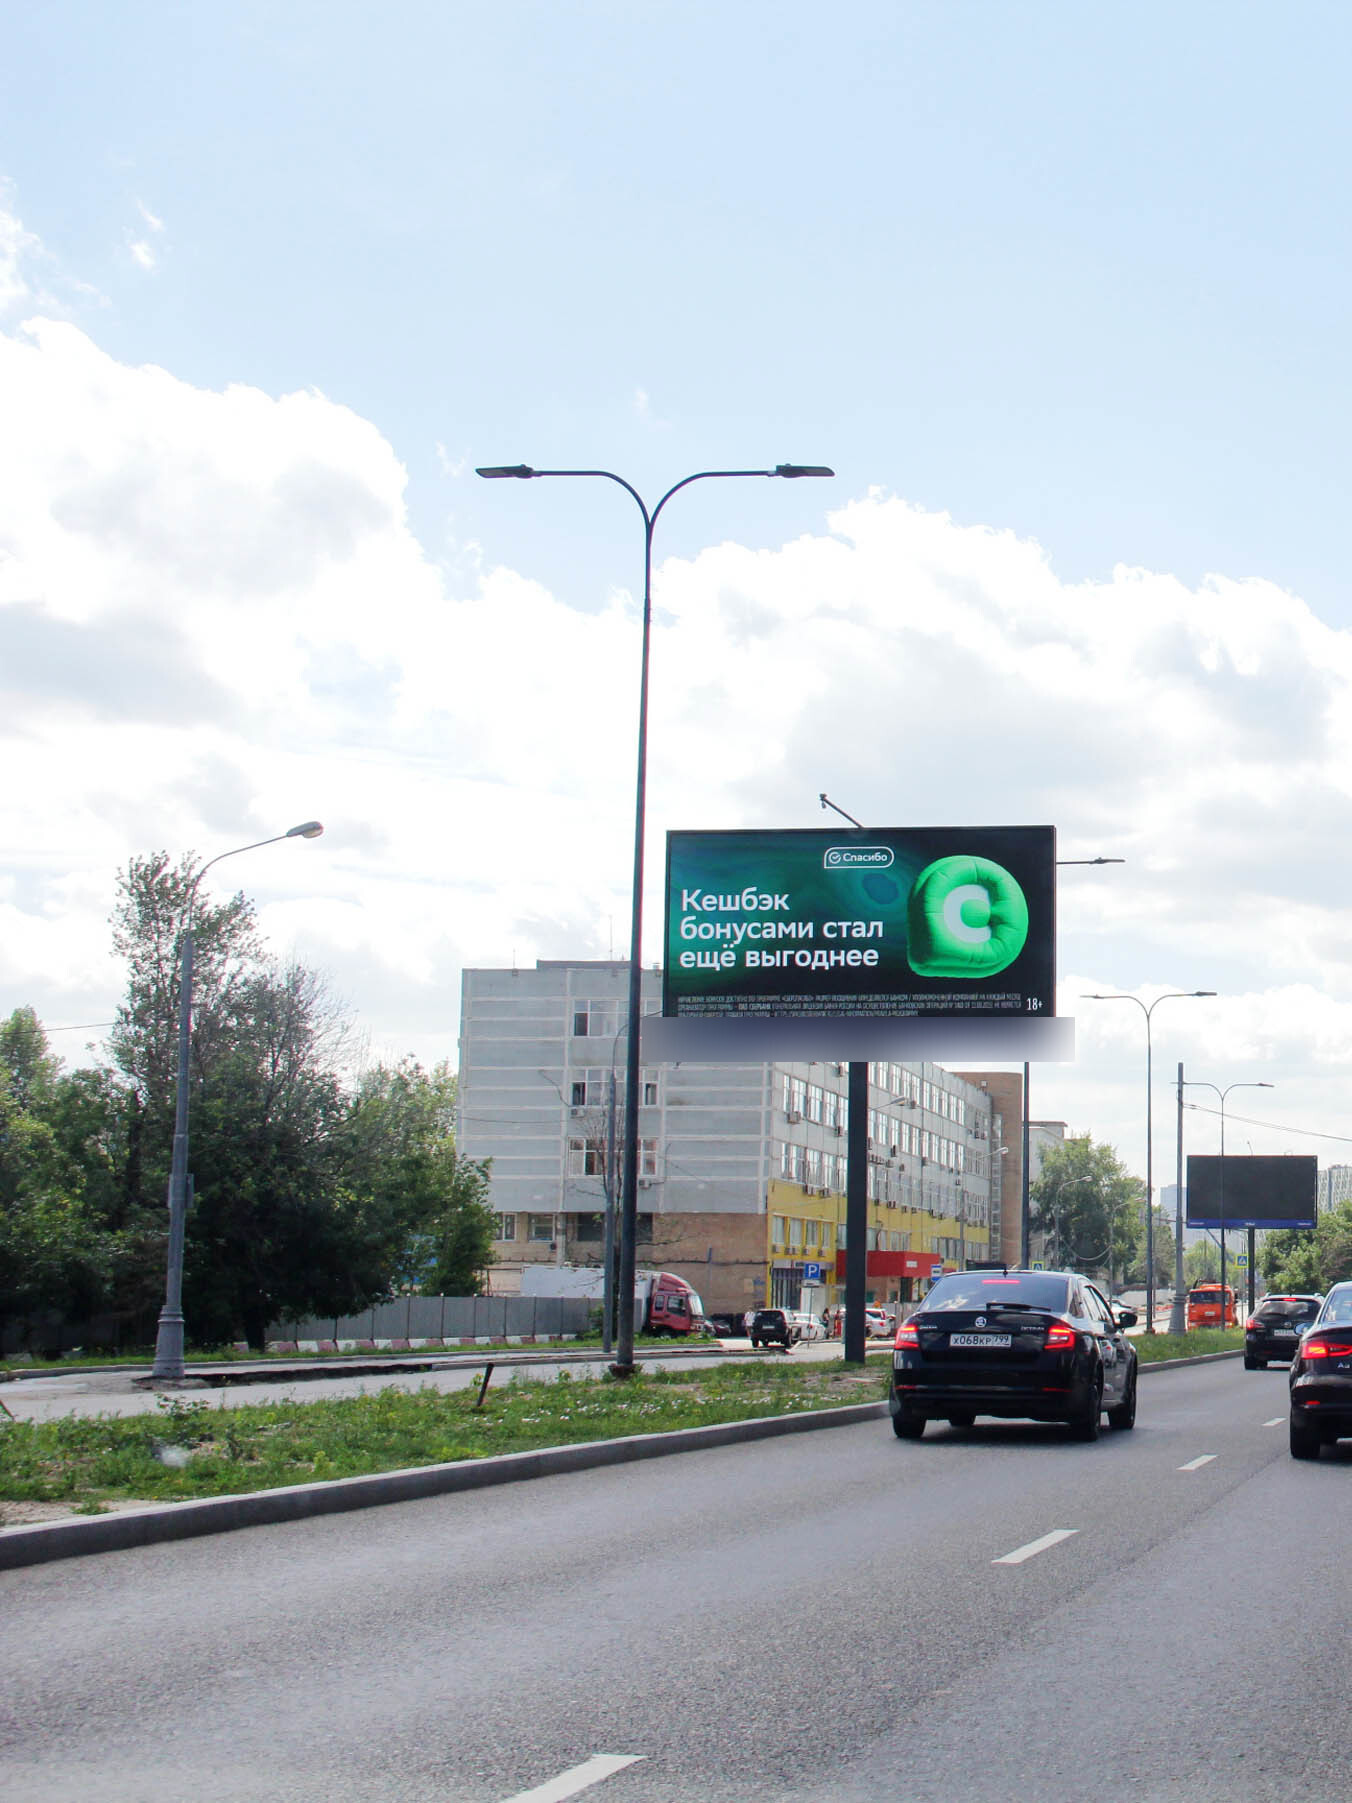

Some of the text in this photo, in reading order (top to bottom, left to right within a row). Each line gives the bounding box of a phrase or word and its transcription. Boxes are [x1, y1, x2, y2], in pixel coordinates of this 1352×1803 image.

[842, 852, 888, 862] Спасибо
[681, 886, 790, 912] Кешбэк
[680, 916, 884, 945] бонусами стал
[679, 943, 879, 971] ещё выгоднее
[1026, 997, 1043, 1010] 18+
